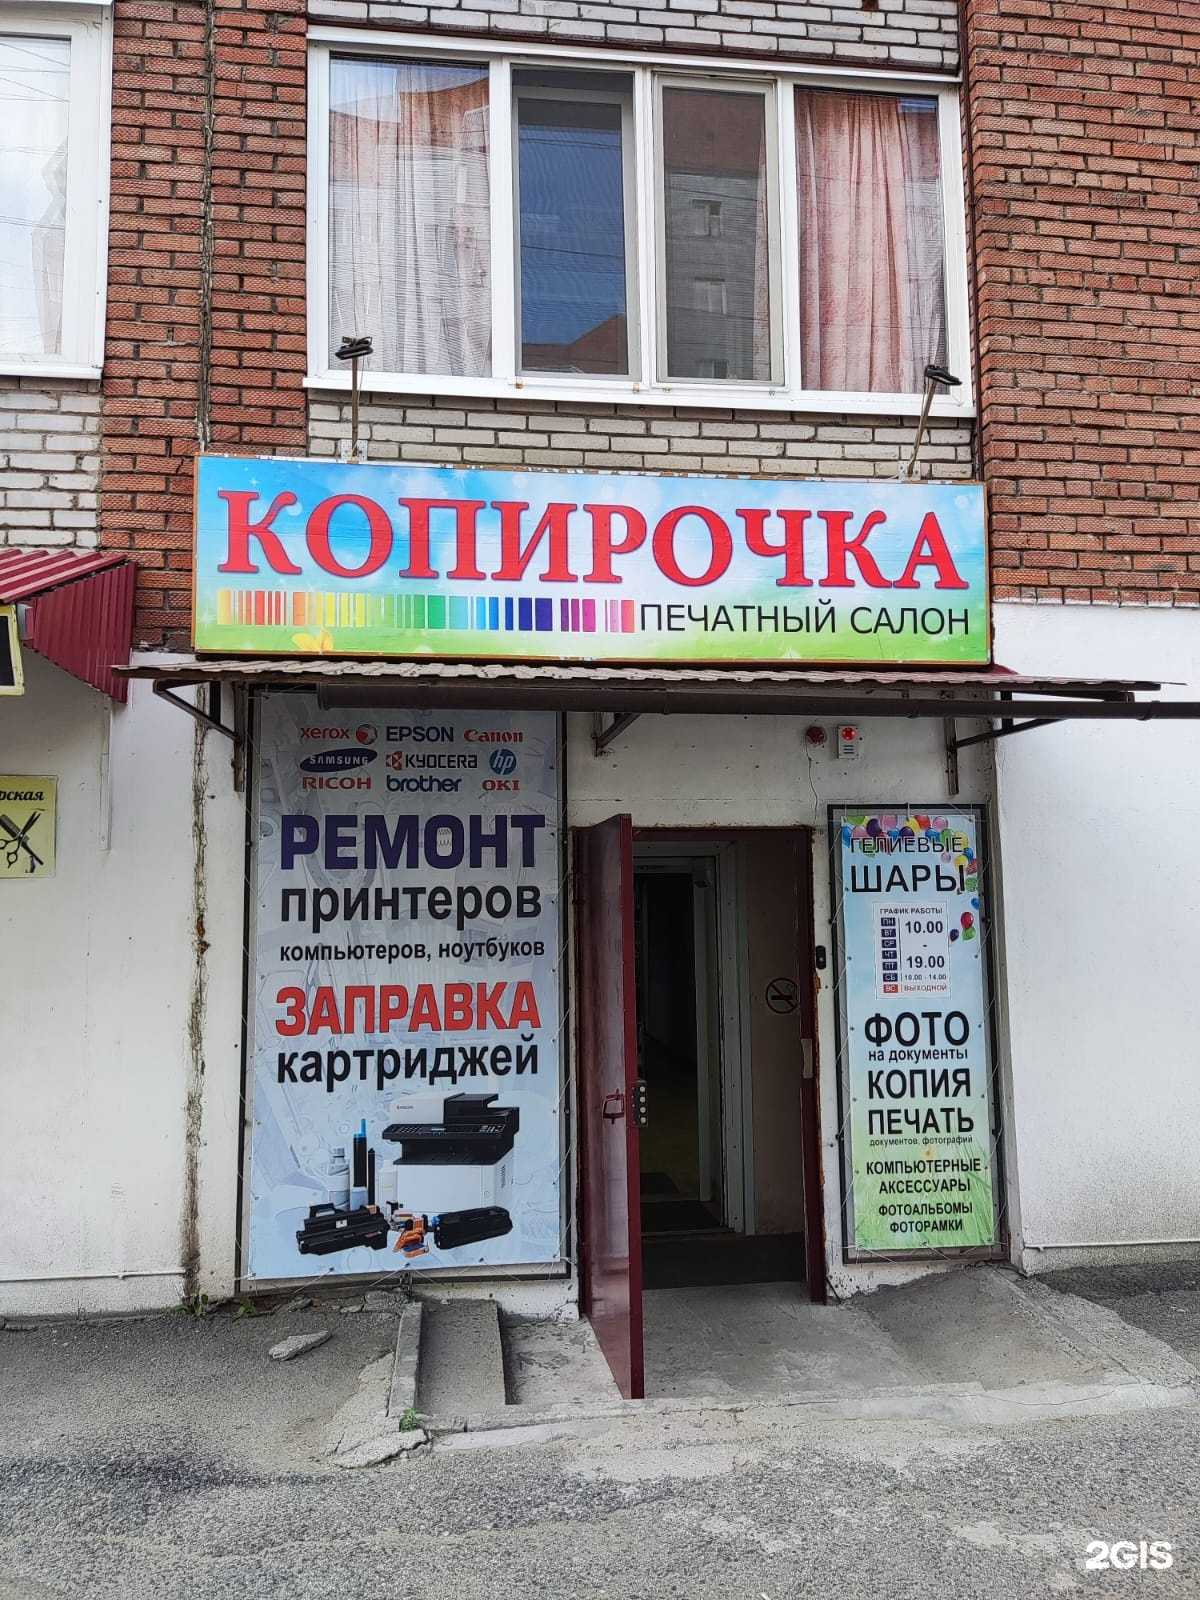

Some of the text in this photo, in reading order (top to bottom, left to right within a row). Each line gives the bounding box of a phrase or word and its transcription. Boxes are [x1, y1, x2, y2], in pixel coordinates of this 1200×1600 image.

[217, 489, 968, 591] КОПИРОЧКА
[641, 599, 969, 635] ПЕЧАТНЫЙ САЛОН
[301, 726, 523, 743] xerox EPSON Canon
[309, 749, 515, 774] SAMSUNG KYOCERA hp
[303, 775, 520, 792] RICOH brother OKI
[281, 814, 545, 870] РЕМОНТ
[851, 837, 964, 854] ГЕЛИЕВЫЕ
[851, 864, 965, 893] ШАРЫ
[281, 885, 542, 933] принтеров
[882, 918, 894, 926] ПН
[905, 920, 944, 934] 10.00
[280, 937, 545, 964] компьютеров, ноутбуков
[906, 955, 945, 968] 19.00
[904, 983, 947, 992] ВЫХОДНОЙ
[275, 981, 542, 1036] ЗАПРАВКА
[864, 1010, 970, 1047] ФОТО
[277, 1033, 538, 1092] картриджей
[868, 1048, 968, 1064] на документы
[868, 1068, 971, 1099] КОПИЯ
[868, 1107, 974, 1135] ПЕЧАТЬ
[922, 1135, 973, 1145] фотографий
[866, 1158, 981, 1175] КОМПЬЮТЕРНЫЕ
[879, 1178, 970, 1194] АКСЕССУАРЫ
[878, 1202, 973, 1216] ФОТОАЛЬБОМЫ
[890, 1219, 963, 1233] ФОТОРАМКИ
